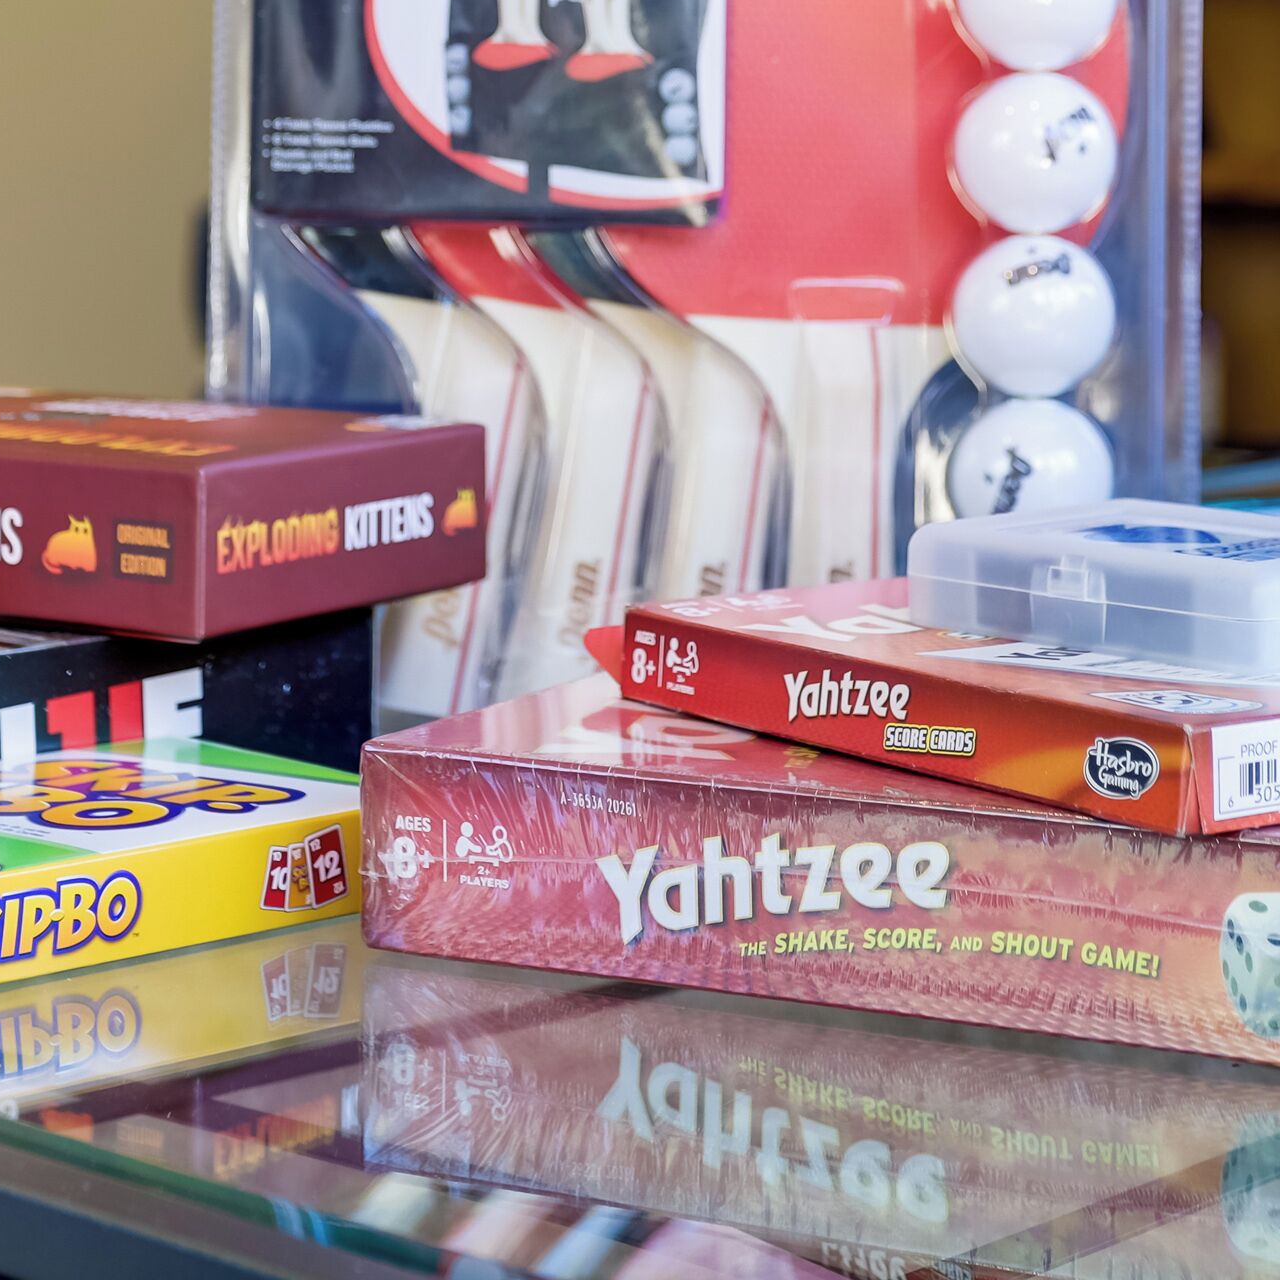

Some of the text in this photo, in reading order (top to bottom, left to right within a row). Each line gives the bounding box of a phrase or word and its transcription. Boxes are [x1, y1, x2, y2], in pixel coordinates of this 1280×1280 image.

[217, 492, 435, 574] EXPLODING KITTENS
[631, 647, 657, 685] 8+
[783, 669, 910, 722] Yahtzee
[885, 725, 975, 754] SCORE CARDS
[1240, 740, 1278, 759] PROOF
[1090, 741, 1152, 777] Hasbro
[1098, 766, 1140, 797] Gaming
[395, 814, 432, 833] AGES
[313, 850, 342, 883] 12
[393, 836, 435, 880] 8+
[477, 866, 491, 875] 2+
[460, 874, 510, 890] PLAYERS
[596, 833, 951, 945] Yahtzee
[739, 928, 1162, 978] THE SHAKE, SCORE, AND SHOUT GAME!
